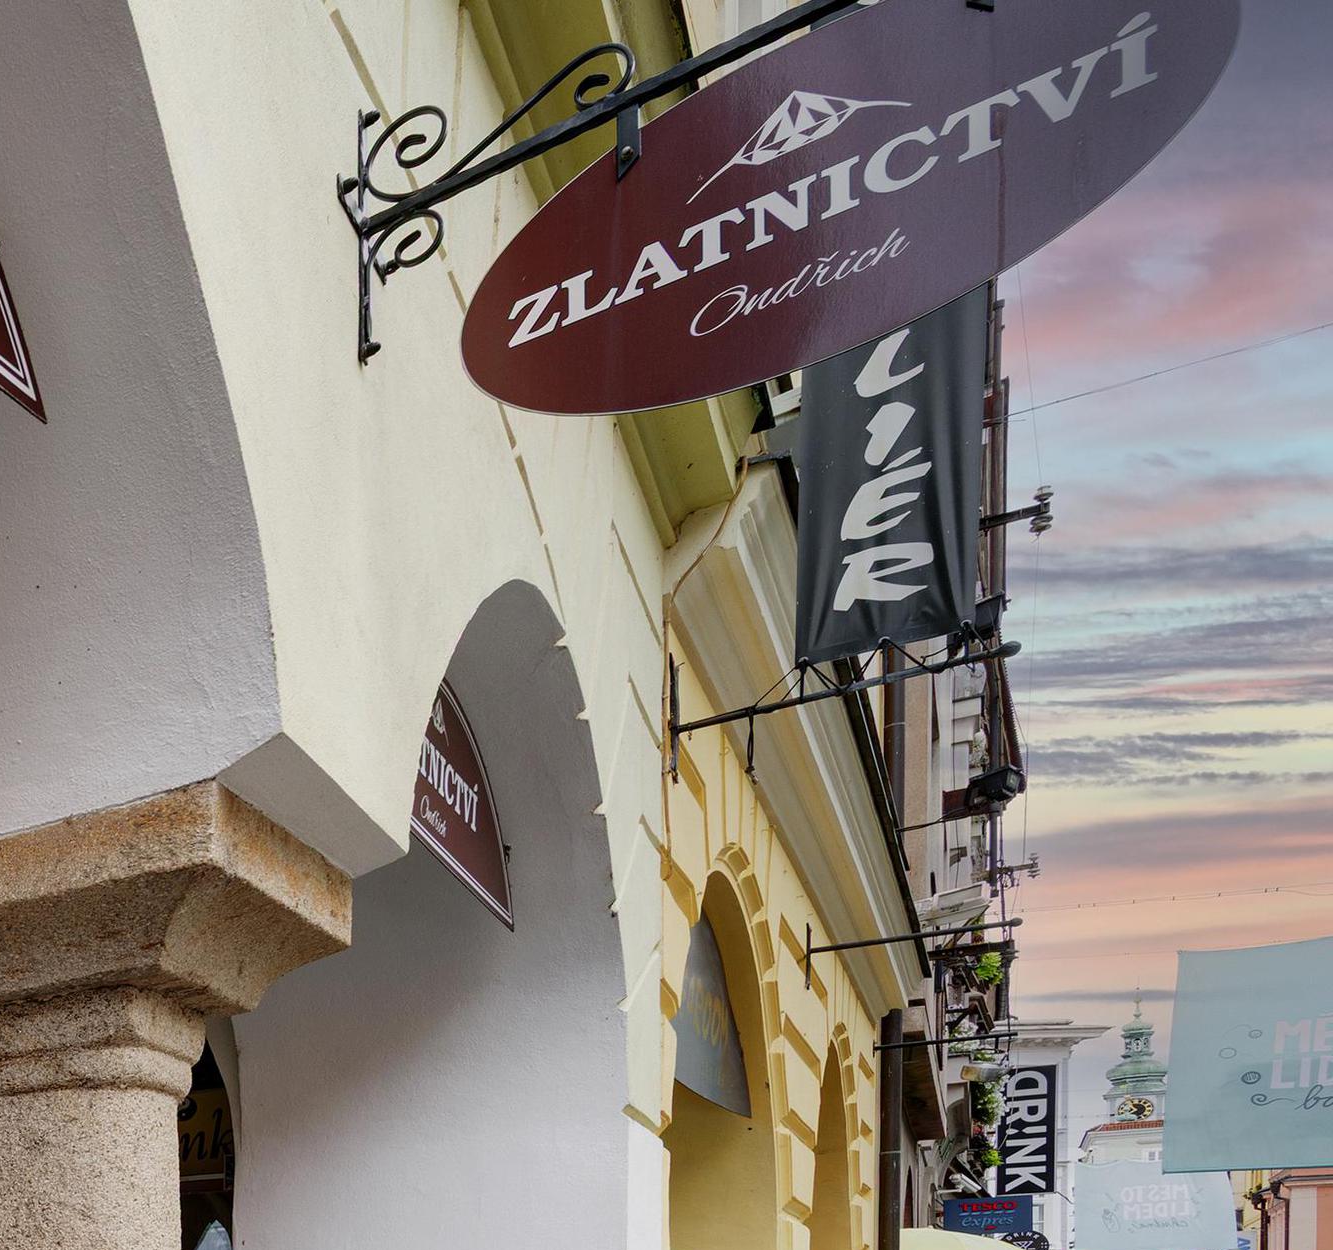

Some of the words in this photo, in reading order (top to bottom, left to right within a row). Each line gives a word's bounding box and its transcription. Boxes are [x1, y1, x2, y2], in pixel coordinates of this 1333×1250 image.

[507, 11, 1159, 349] ZLATNICTVÍ
[689, 227, 911, 339] Ondřich
[959, 1200, 1018, 1213] TESCO
